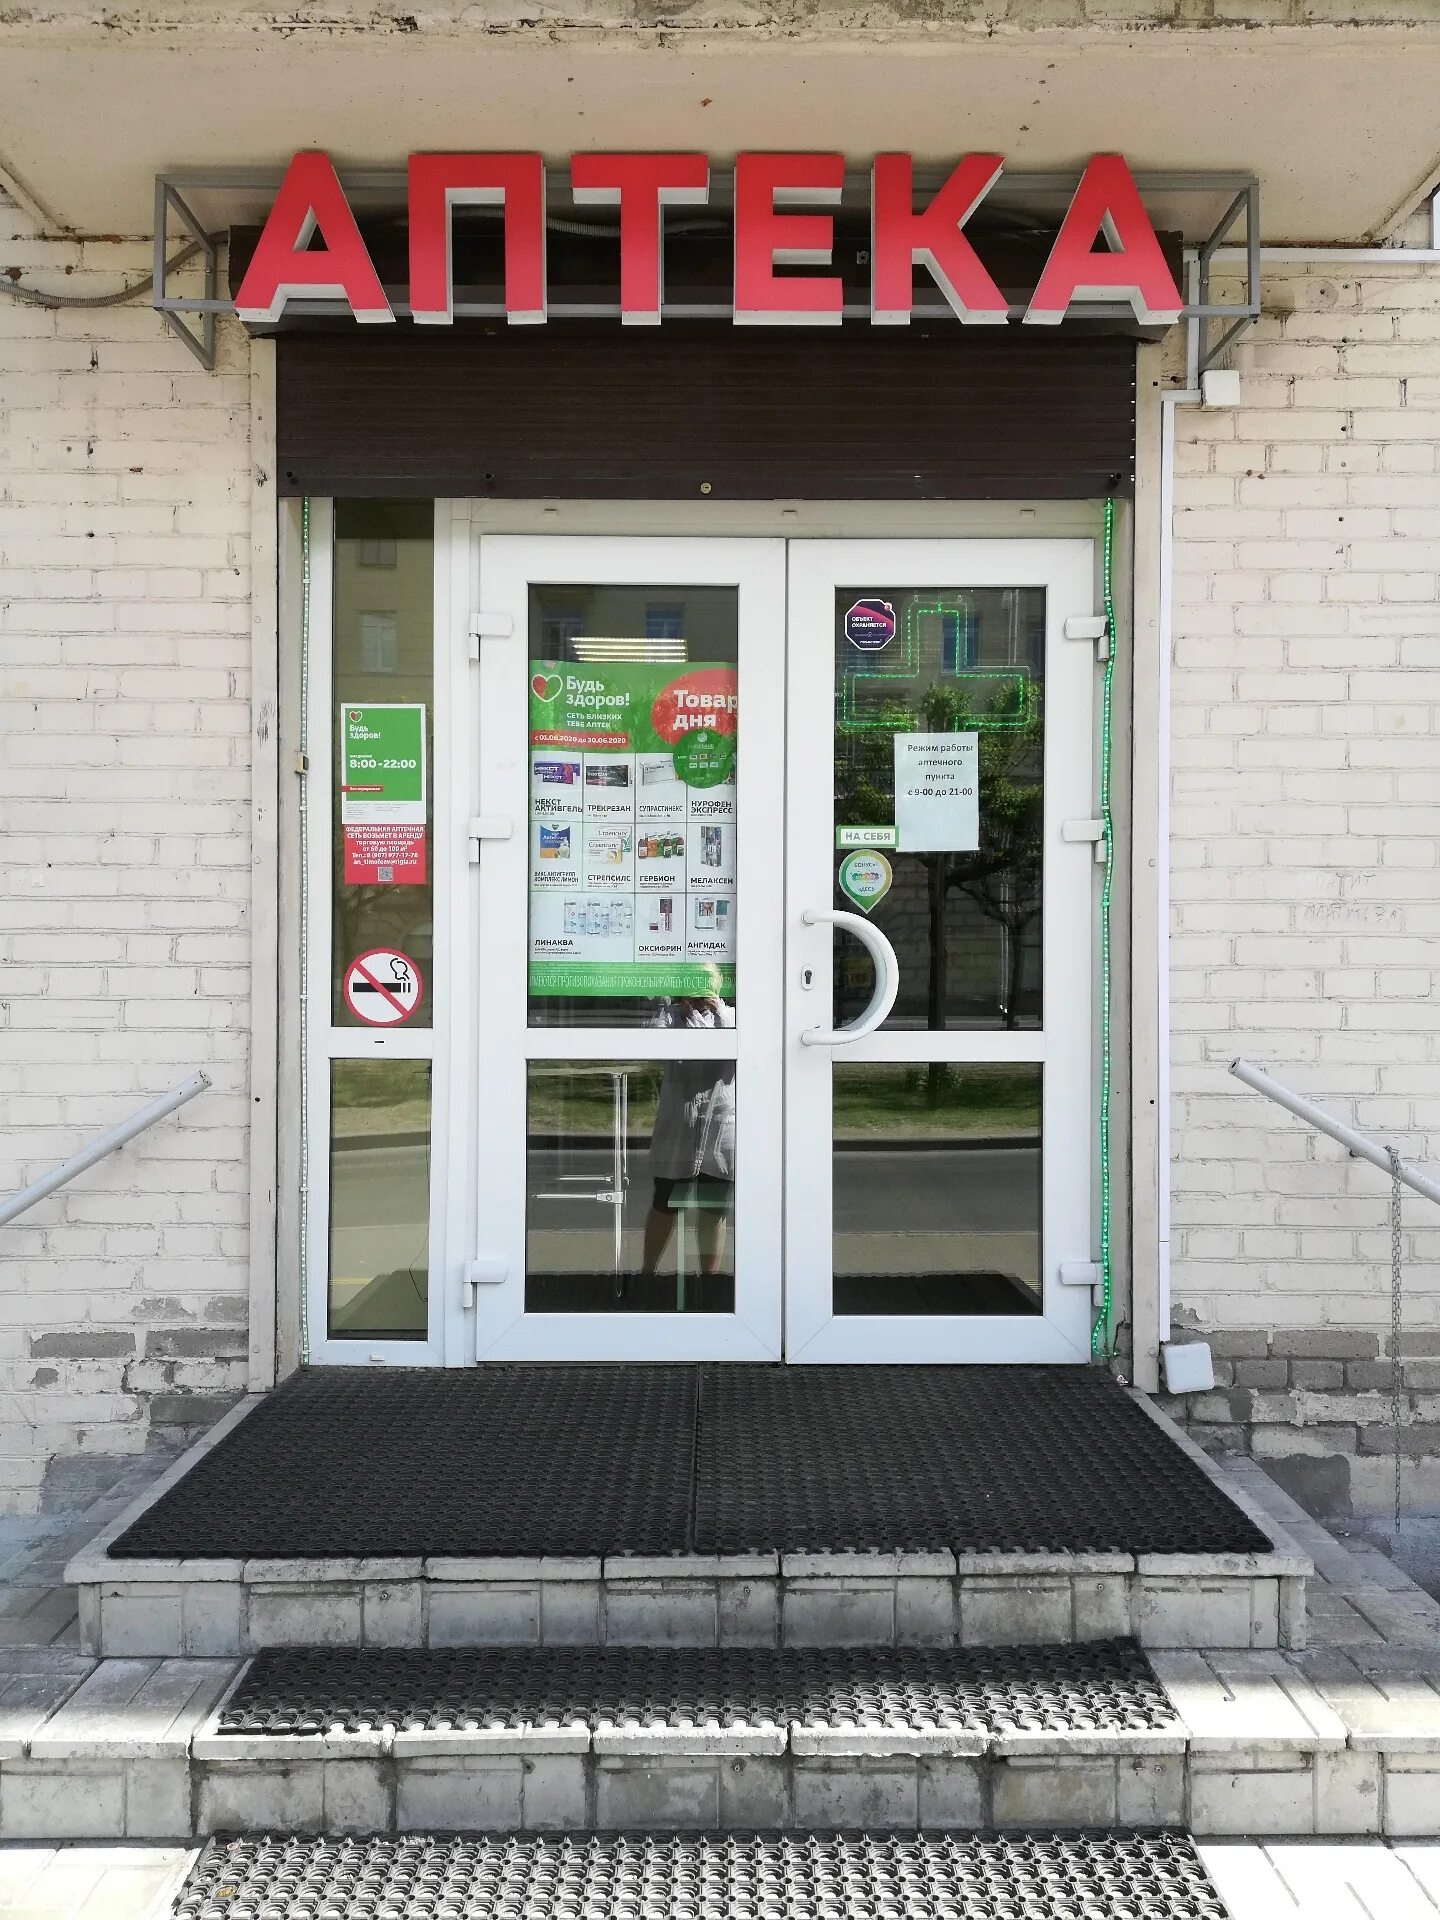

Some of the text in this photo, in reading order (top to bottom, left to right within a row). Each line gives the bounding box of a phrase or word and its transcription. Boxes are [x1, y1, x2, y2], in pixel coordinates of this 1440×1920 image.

[236, 151, 1184, 325] АПТЕКА
[566, 675, 605, 695] Будь
[566, 692, 630, 710] здоров!
[586, 713, 623, 721] БЛИЗКИХ
[566, 720, 584, 728] ТЕБЕ
[673, 713, 717, 731] дня
[349, 724, 368, 733] Будь
[349, 731, 381, 741] здоров!
[907, 744, 974, 754] Режим работы
[925, 774, 955, 782] пункта
[914, 788, 934, 796] 9-00
[935, 789, 947, 797] до
[948, 788, 973, 796] 21-00
[535, 798, 562, 806] НЕКСТ
[691, 800, 733, 808] НУРОФЕН
[535, 804, 583, 813] АКТИВГЕЛЬ
[587, 804, 632, 812] ТРЕКРЕЗАН
[691, 806, 734, 814] ЭКСПРЕСС
[845, 832, 891, 841] НА СЕБЯ
[587, 874, 631, 882] СТРЕПСИЛС
[690, 877, 733, 885] МЕЛАКСЕН
[687, 942, 726, 950] АНГИДАК
